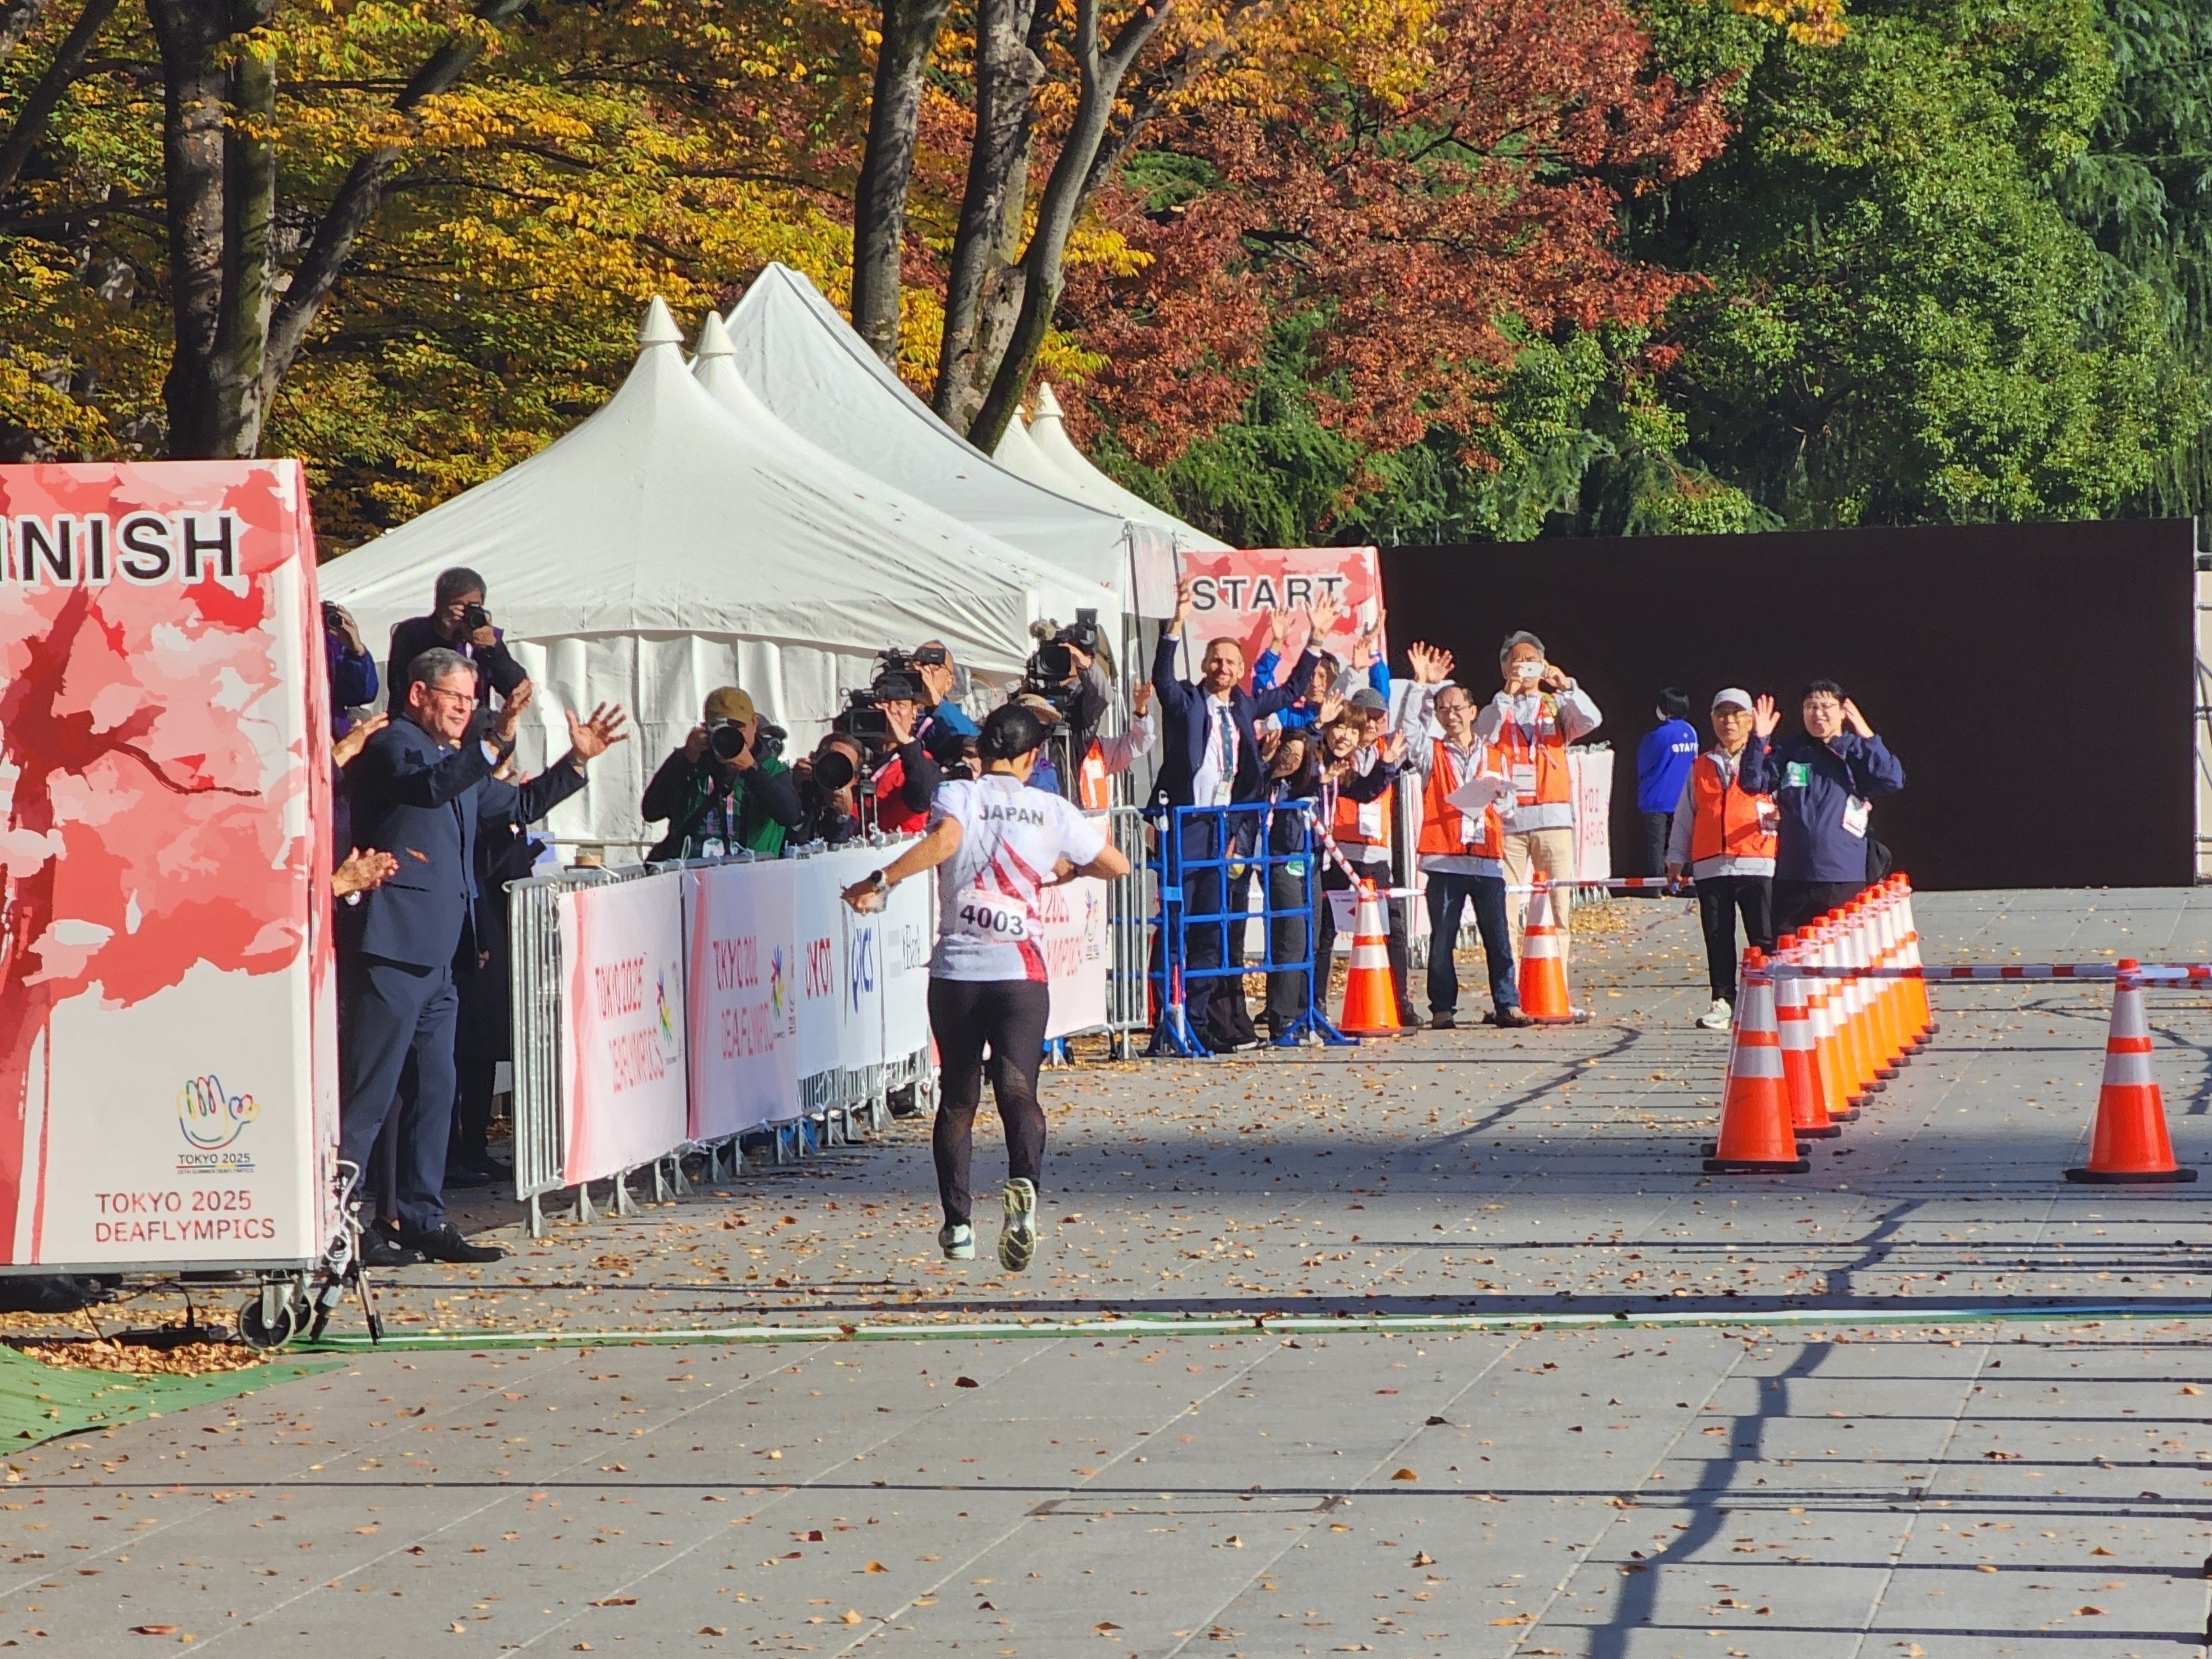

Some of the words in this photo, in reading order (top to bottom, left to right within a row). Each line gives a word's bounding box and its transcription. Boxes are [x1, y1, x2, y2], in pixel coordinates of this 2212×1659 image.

[0, 517, 233, 581] NISH
[1192, 577, 1343, 611] START
[979, 804, 1044, 826] JAPAN
[959, 904, 1024, 936] 4003
[713, 936, 743, 990] TKYO
[178, 1154, 218, 1164] TOKYO
[222, 1153, 251, 1164] 2025
[95, 1191, 182, 1214] TOKYO
[191, 1190, 252, 1212] 2025
[95, 1218, 276, 1243] DEAFLYMPICS
